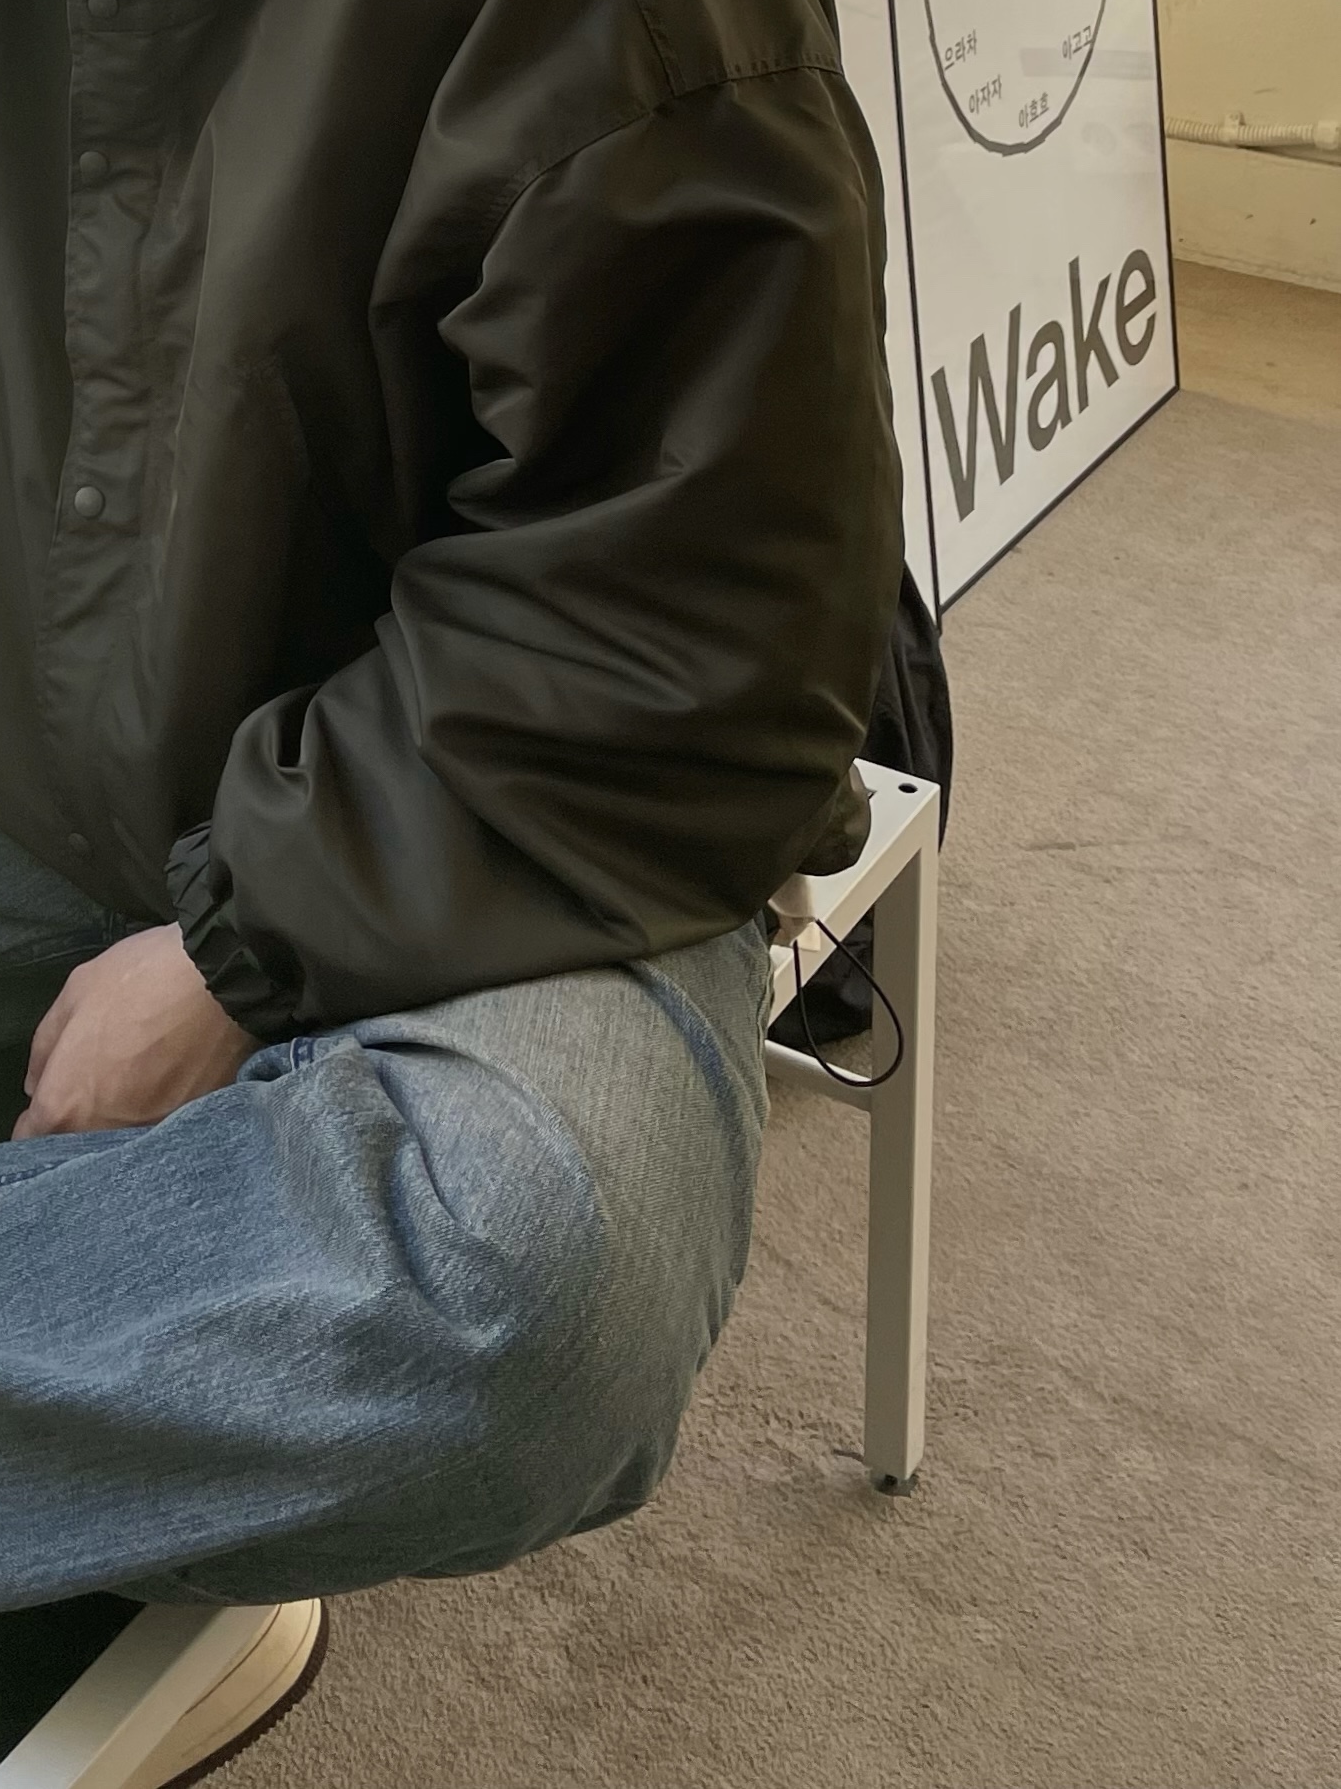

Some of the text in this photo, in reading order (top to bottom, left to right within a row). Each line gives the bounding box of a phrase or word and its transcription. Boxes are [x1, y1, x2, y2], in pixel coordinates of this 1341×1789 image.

[944, 29, 978, 71] 으라차
[1062, 25, 1094, 60] 아고고
[968, 74, 1003, 115] 아자자
[930, 248, 1157, 524] Wake
